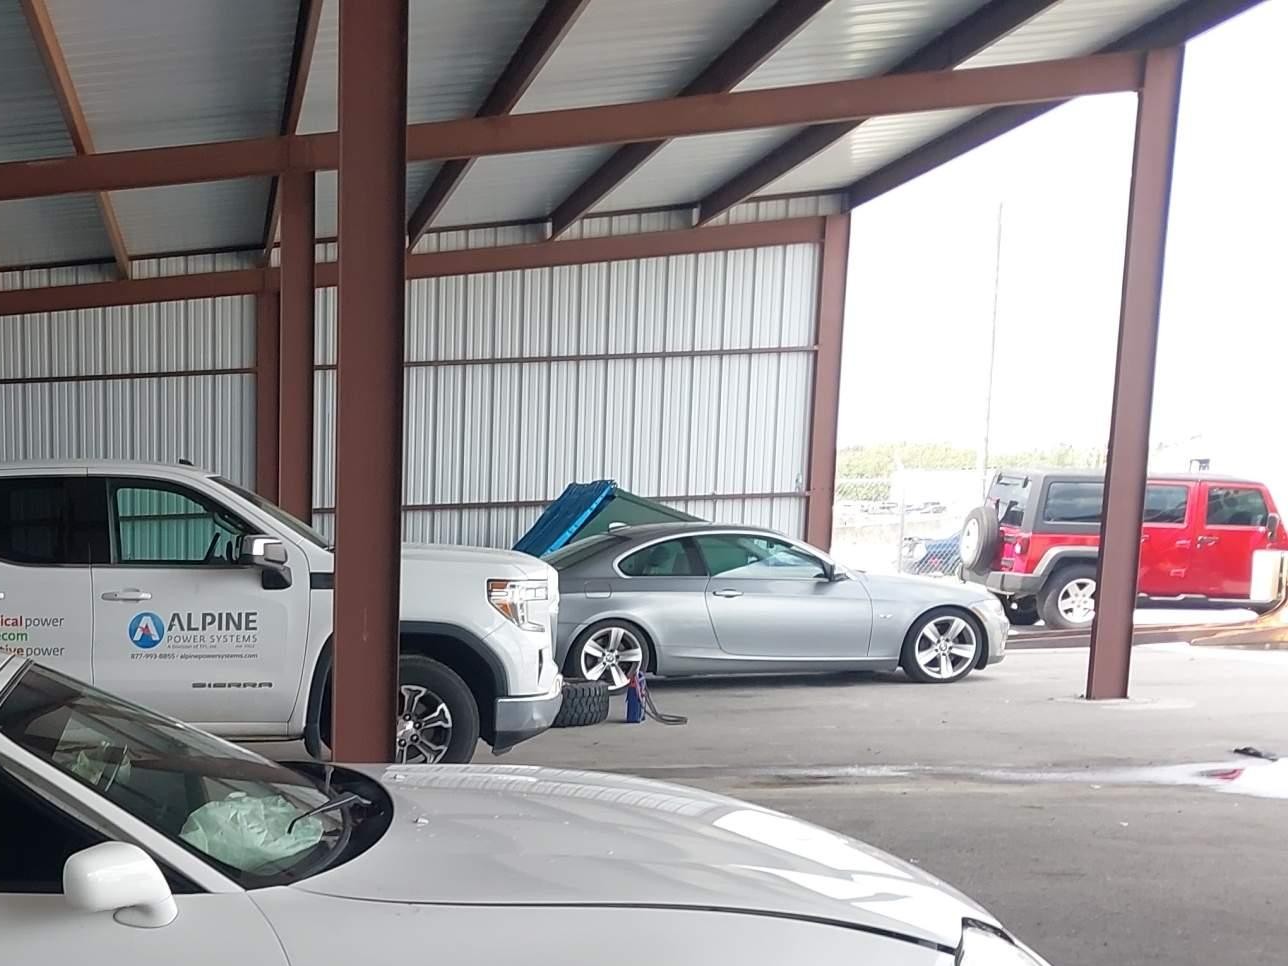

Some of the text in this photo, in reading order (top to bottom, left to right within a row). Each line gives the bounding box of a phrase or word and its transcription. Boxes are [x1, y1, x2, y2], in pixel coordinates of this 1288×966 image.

[25, 616, 65, 630] power
[167, 612, 258, 631] ALPINE
[167, 634, 258, 644] POWER SYSTEMS
[25, 646, 65, 657] power
[179, 653, 258, 661] alpinepowersystems.com
